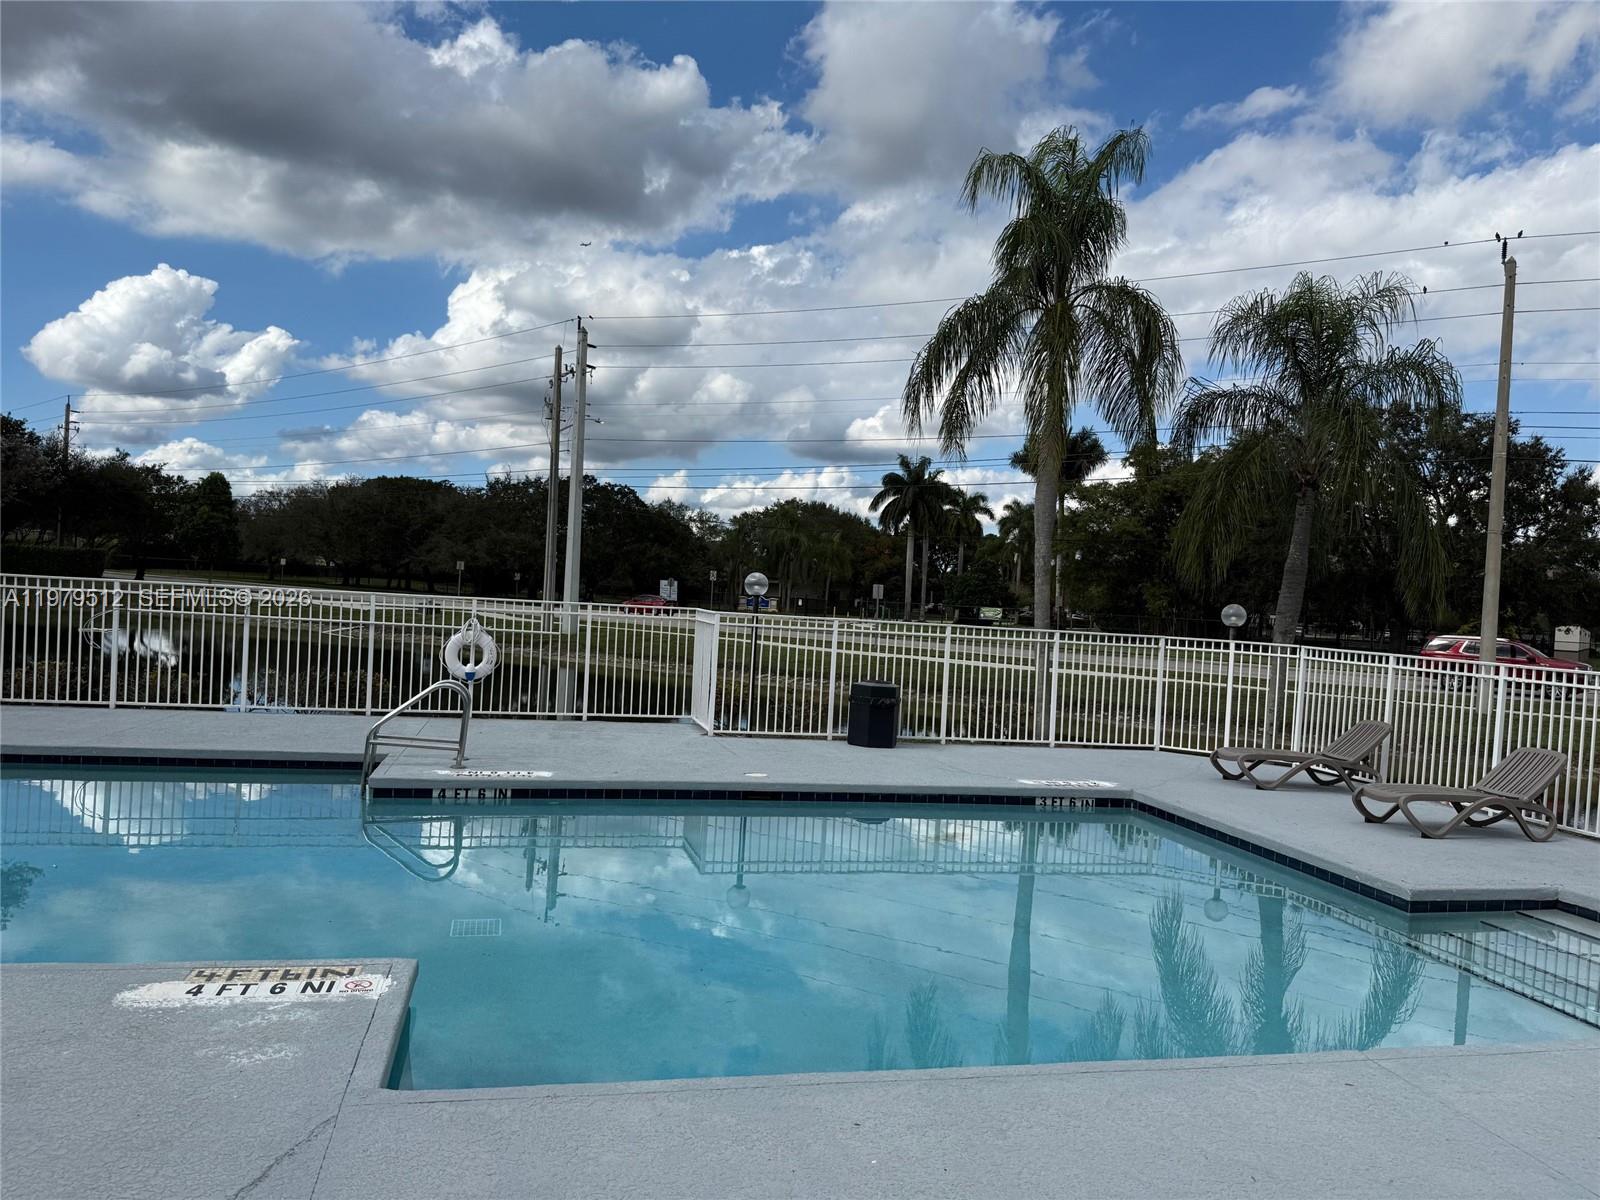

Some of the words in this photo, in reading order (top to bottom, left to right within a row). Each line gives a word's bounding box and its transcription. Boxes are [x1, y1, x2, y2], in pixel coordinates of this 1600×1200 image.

[438, 788, 446, 799] 4
[454, 788, 471, 799] FT
[478, 788, 486, 799] 6
[494, 788, 508, 799] IN
[1040, 796, 1047, 806] 3
[1052, 797, 1065, 806] FT
[1069, 797, 1076, 807] 6
[1081, 799, 1095, 807] IN
[185, 984, 205, 997] 4
[216, 983, 259, 996] FT
[269, 982, 288, 995] 6
[300, 981, 336, 994] NI
